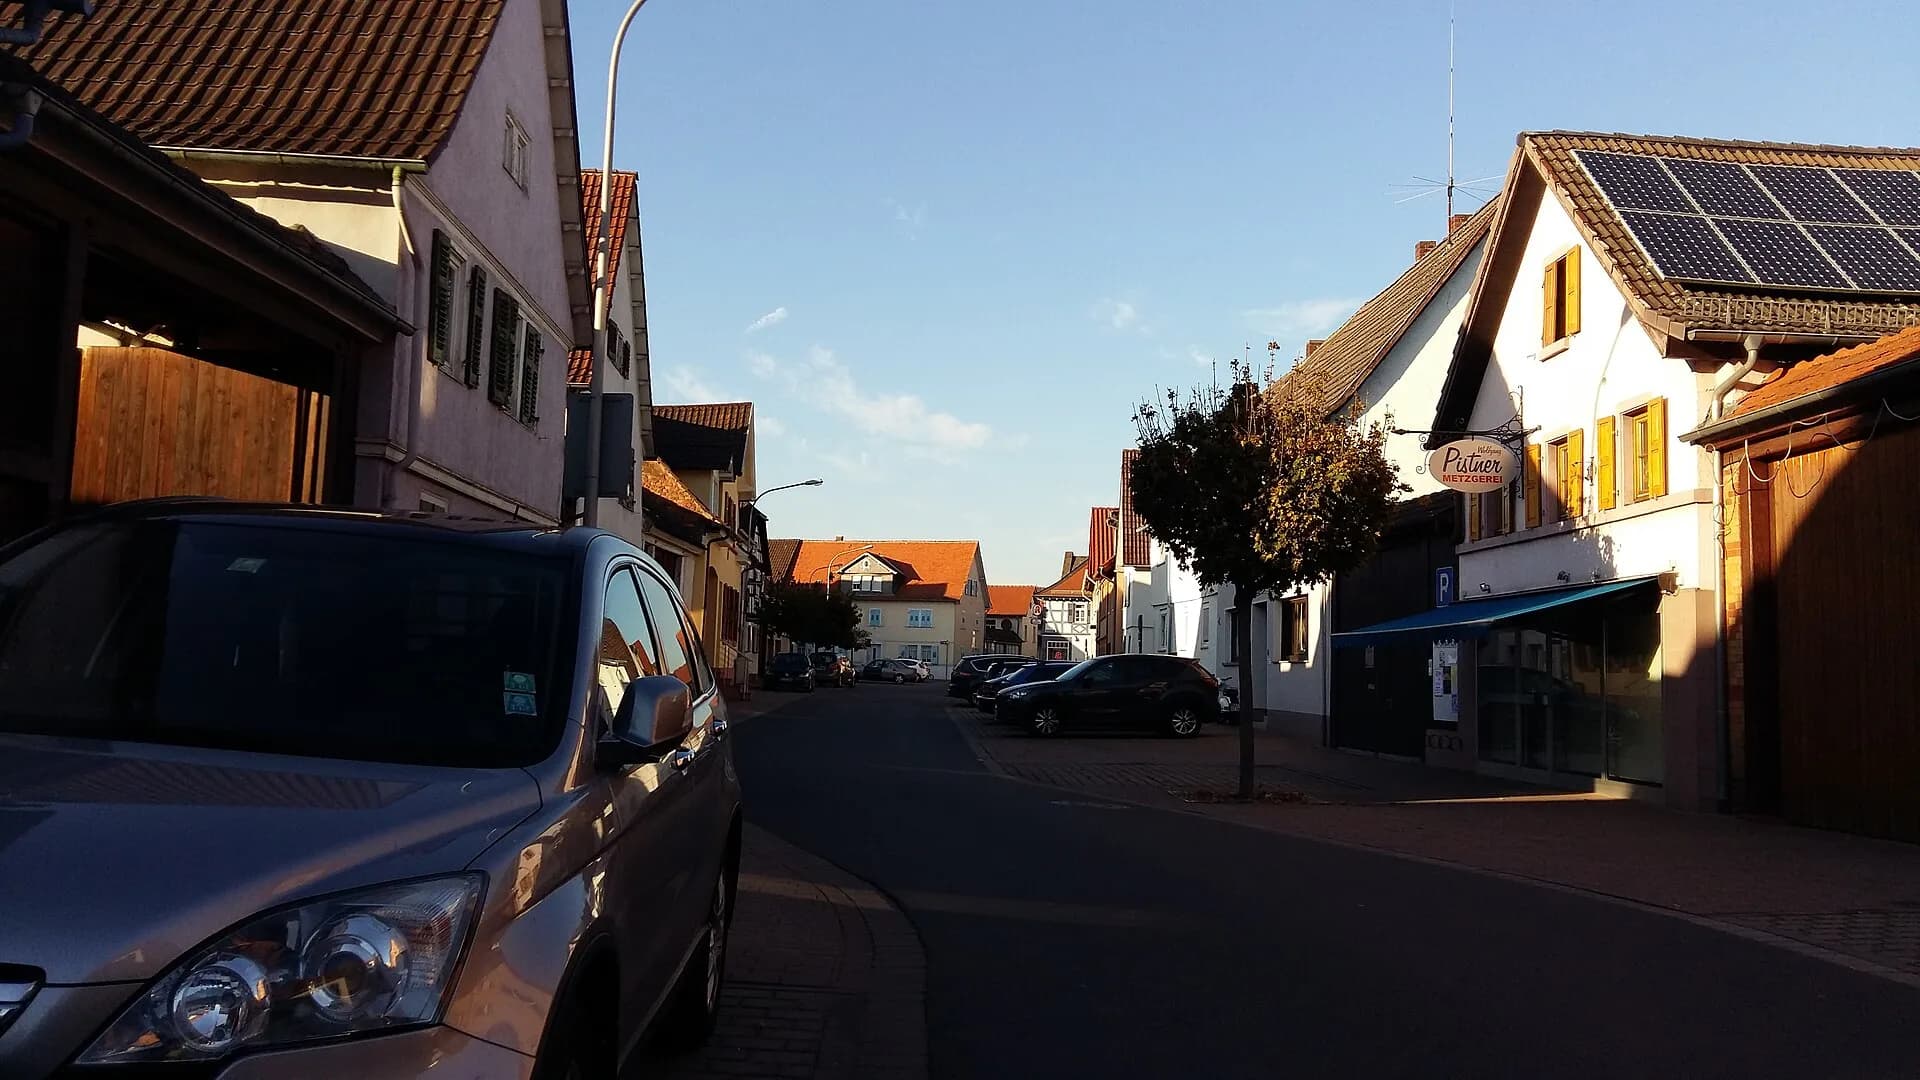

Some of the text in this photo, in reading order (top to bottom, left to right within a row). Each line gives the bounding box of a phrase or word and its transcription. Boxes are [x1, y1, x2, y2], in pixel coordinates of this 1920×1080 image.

[1442, 447, 1502, 473] Pistner
[1442, 474, 1503, 484] METZGEREI
[1440, 573, 1450, 601] P
